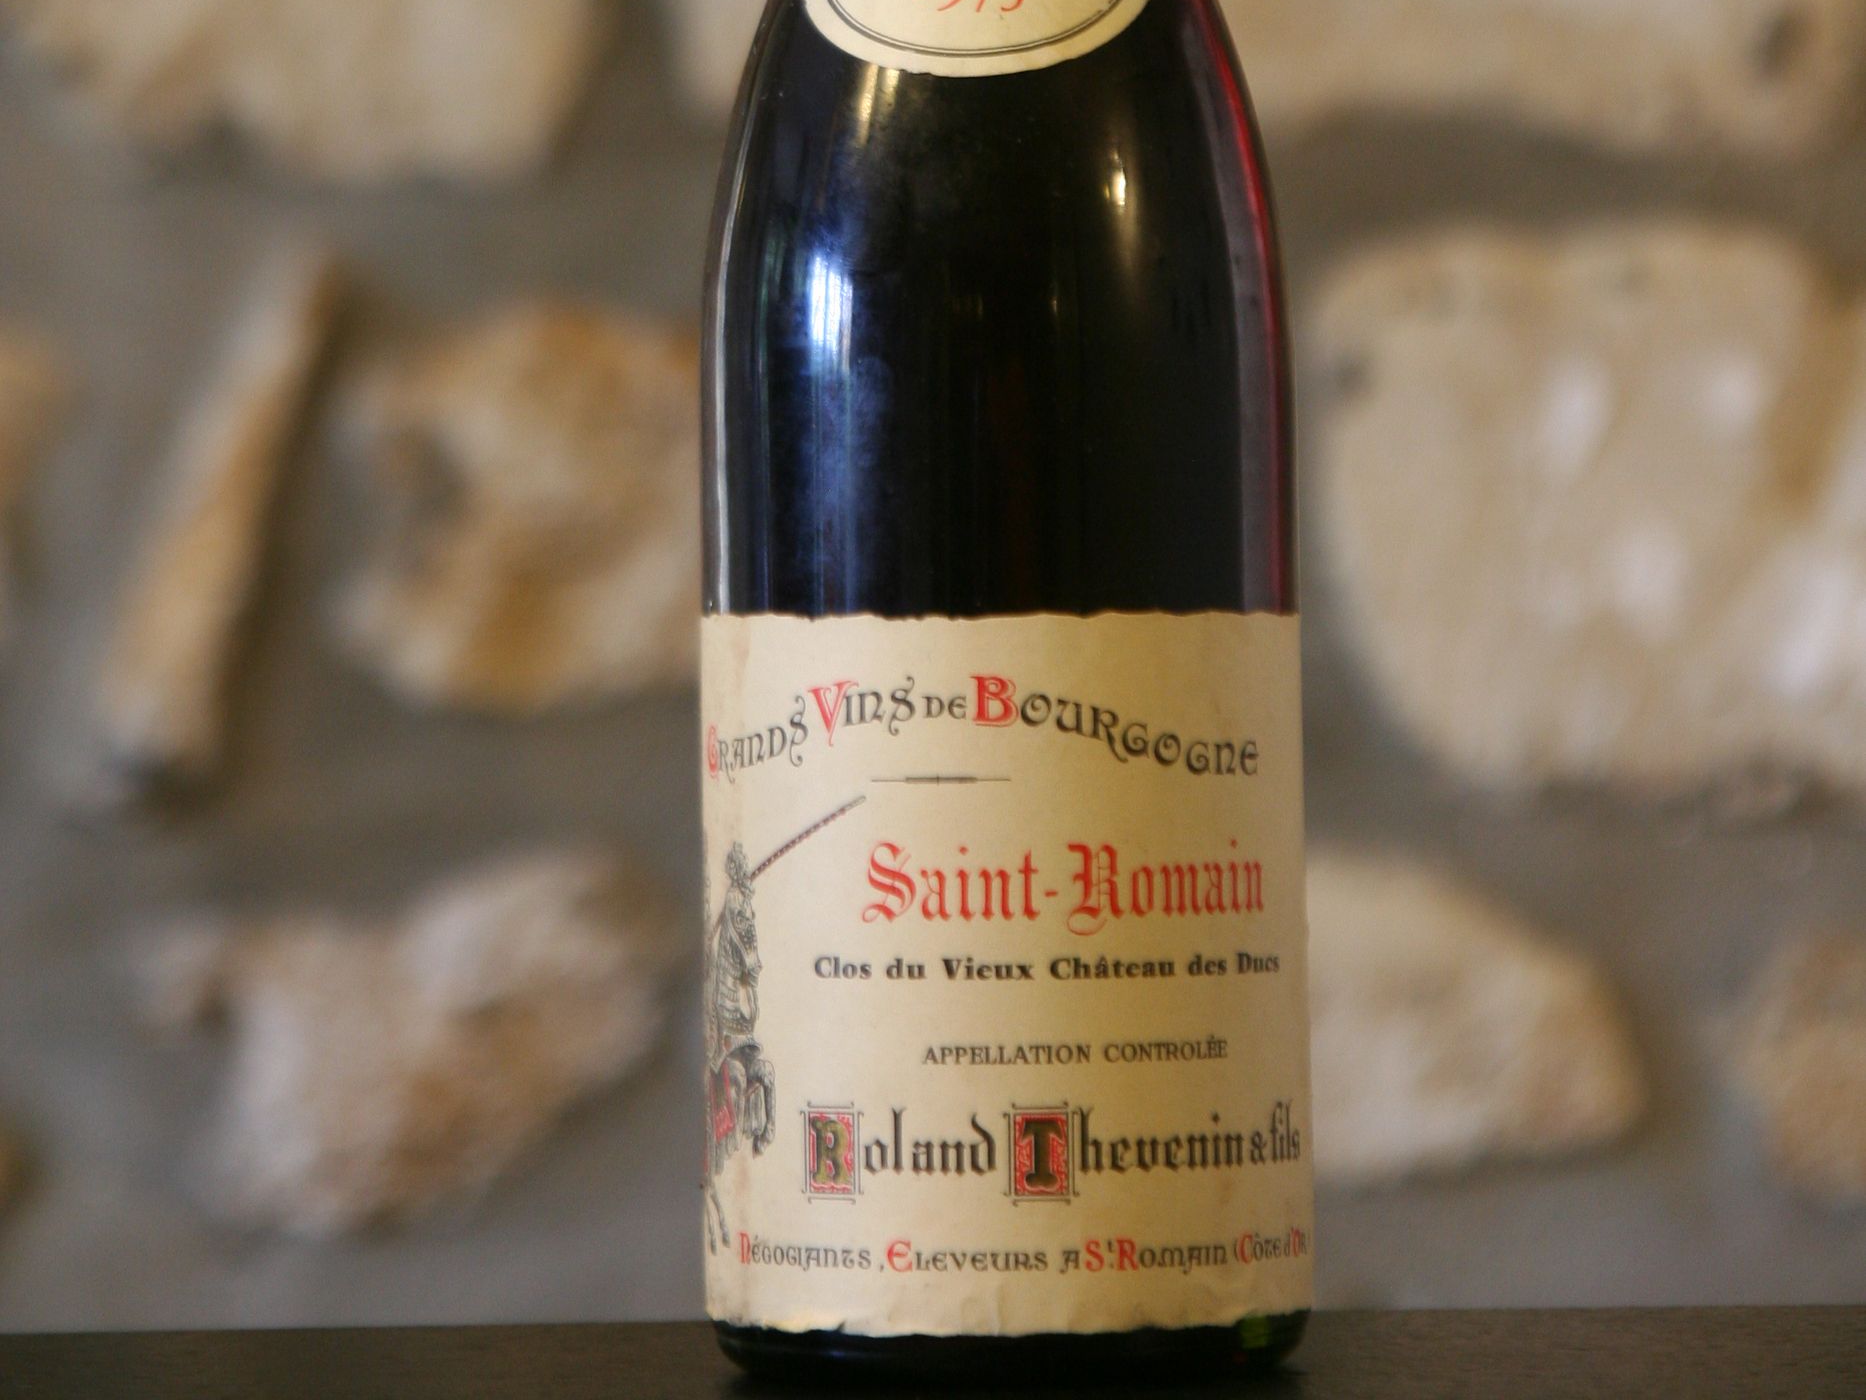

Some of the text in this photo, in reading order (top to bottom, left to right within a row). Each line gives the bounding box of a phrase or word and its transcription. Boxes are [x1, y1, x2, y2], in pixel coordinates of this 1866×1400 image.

[861, 838, 1266, 937] Saint-Romain
[814, 952, 1280, 980] Clos du Vieux Château des Ducs
[922, 1044, 1091, 1066] APPELLATION
[806, 1106, 997, 1192] Roland
